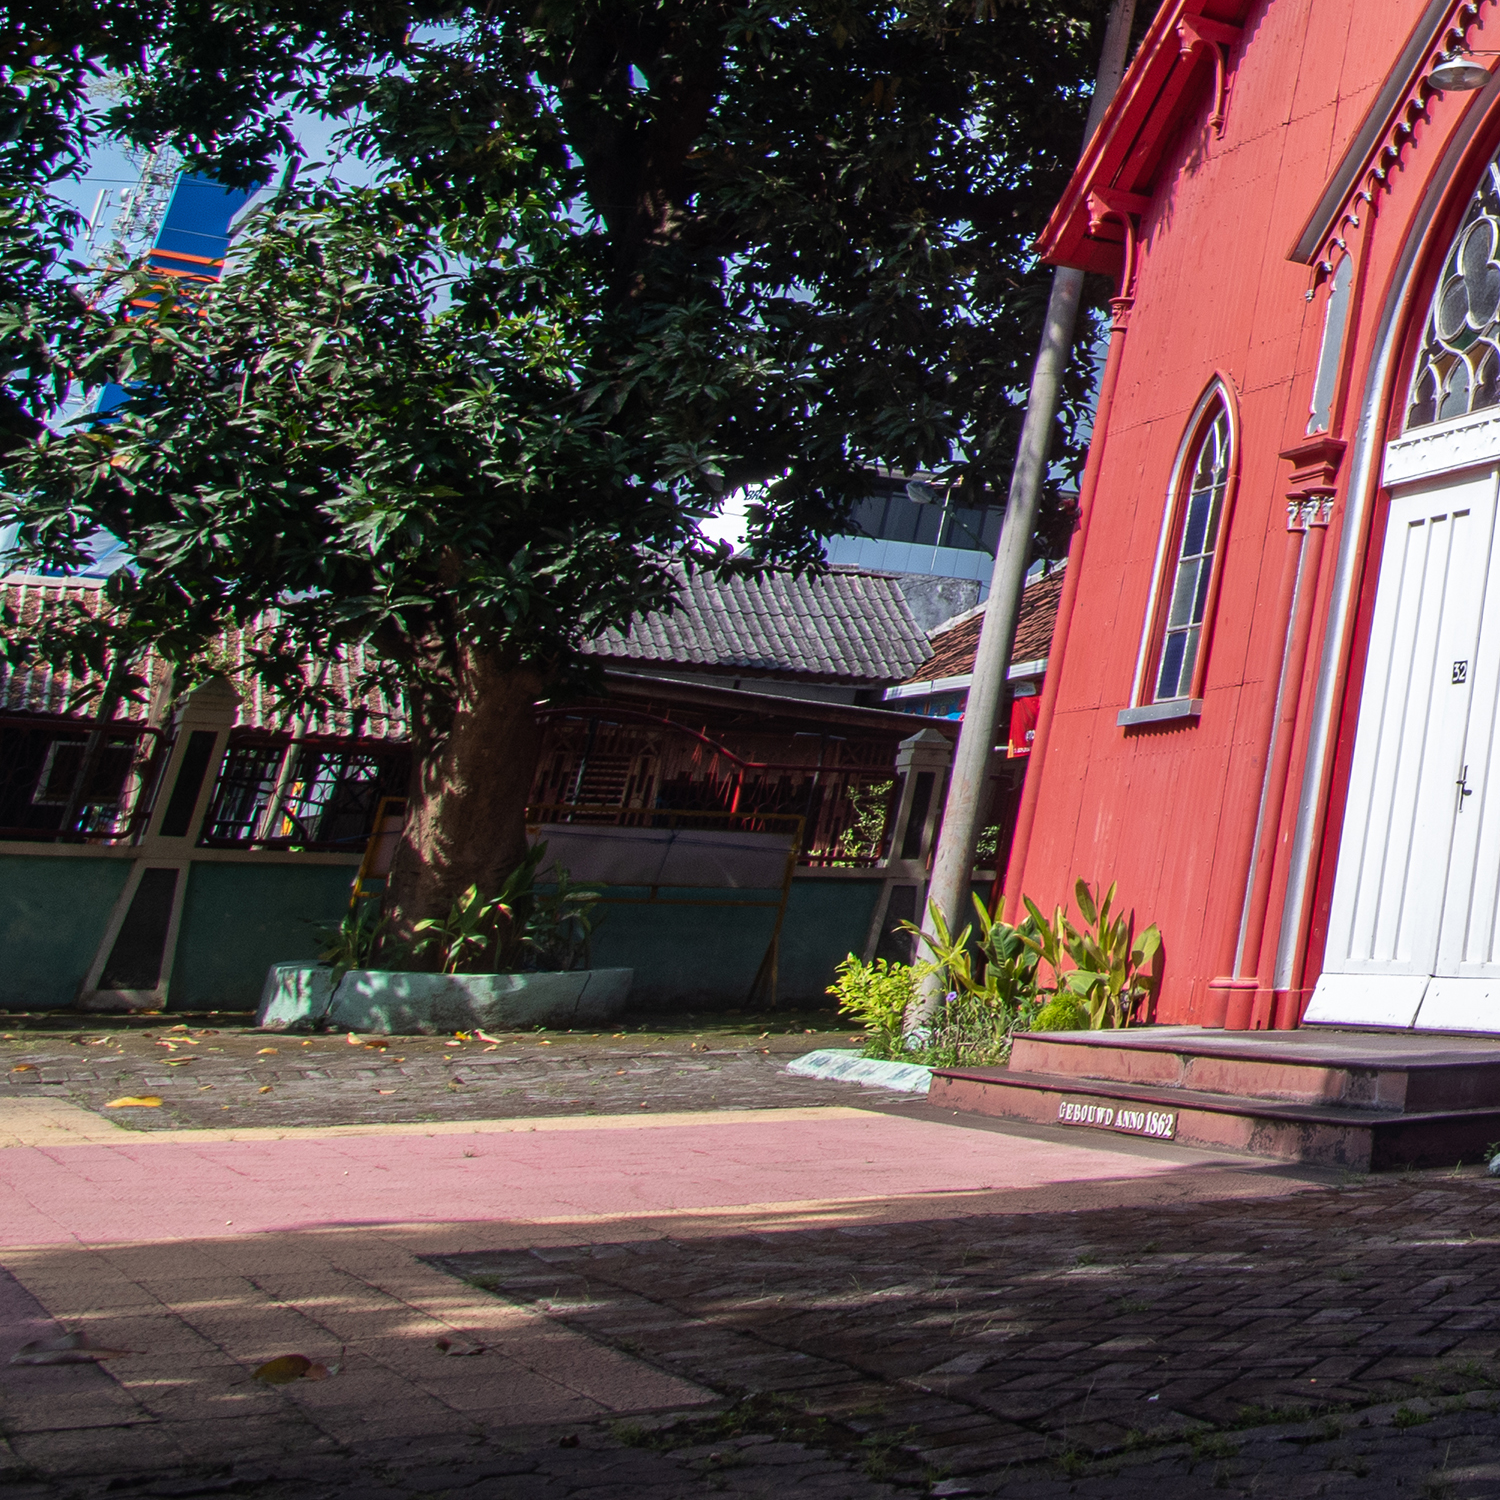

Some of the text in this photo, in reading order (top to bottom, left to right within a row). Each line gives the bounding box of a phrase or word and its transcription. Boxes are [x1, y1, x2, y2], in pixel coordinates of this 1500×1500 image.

[1453, 662, 1467, 681] 32
[1058, 1102, 1174, 1137] GEBOUWD ANNO 1862
